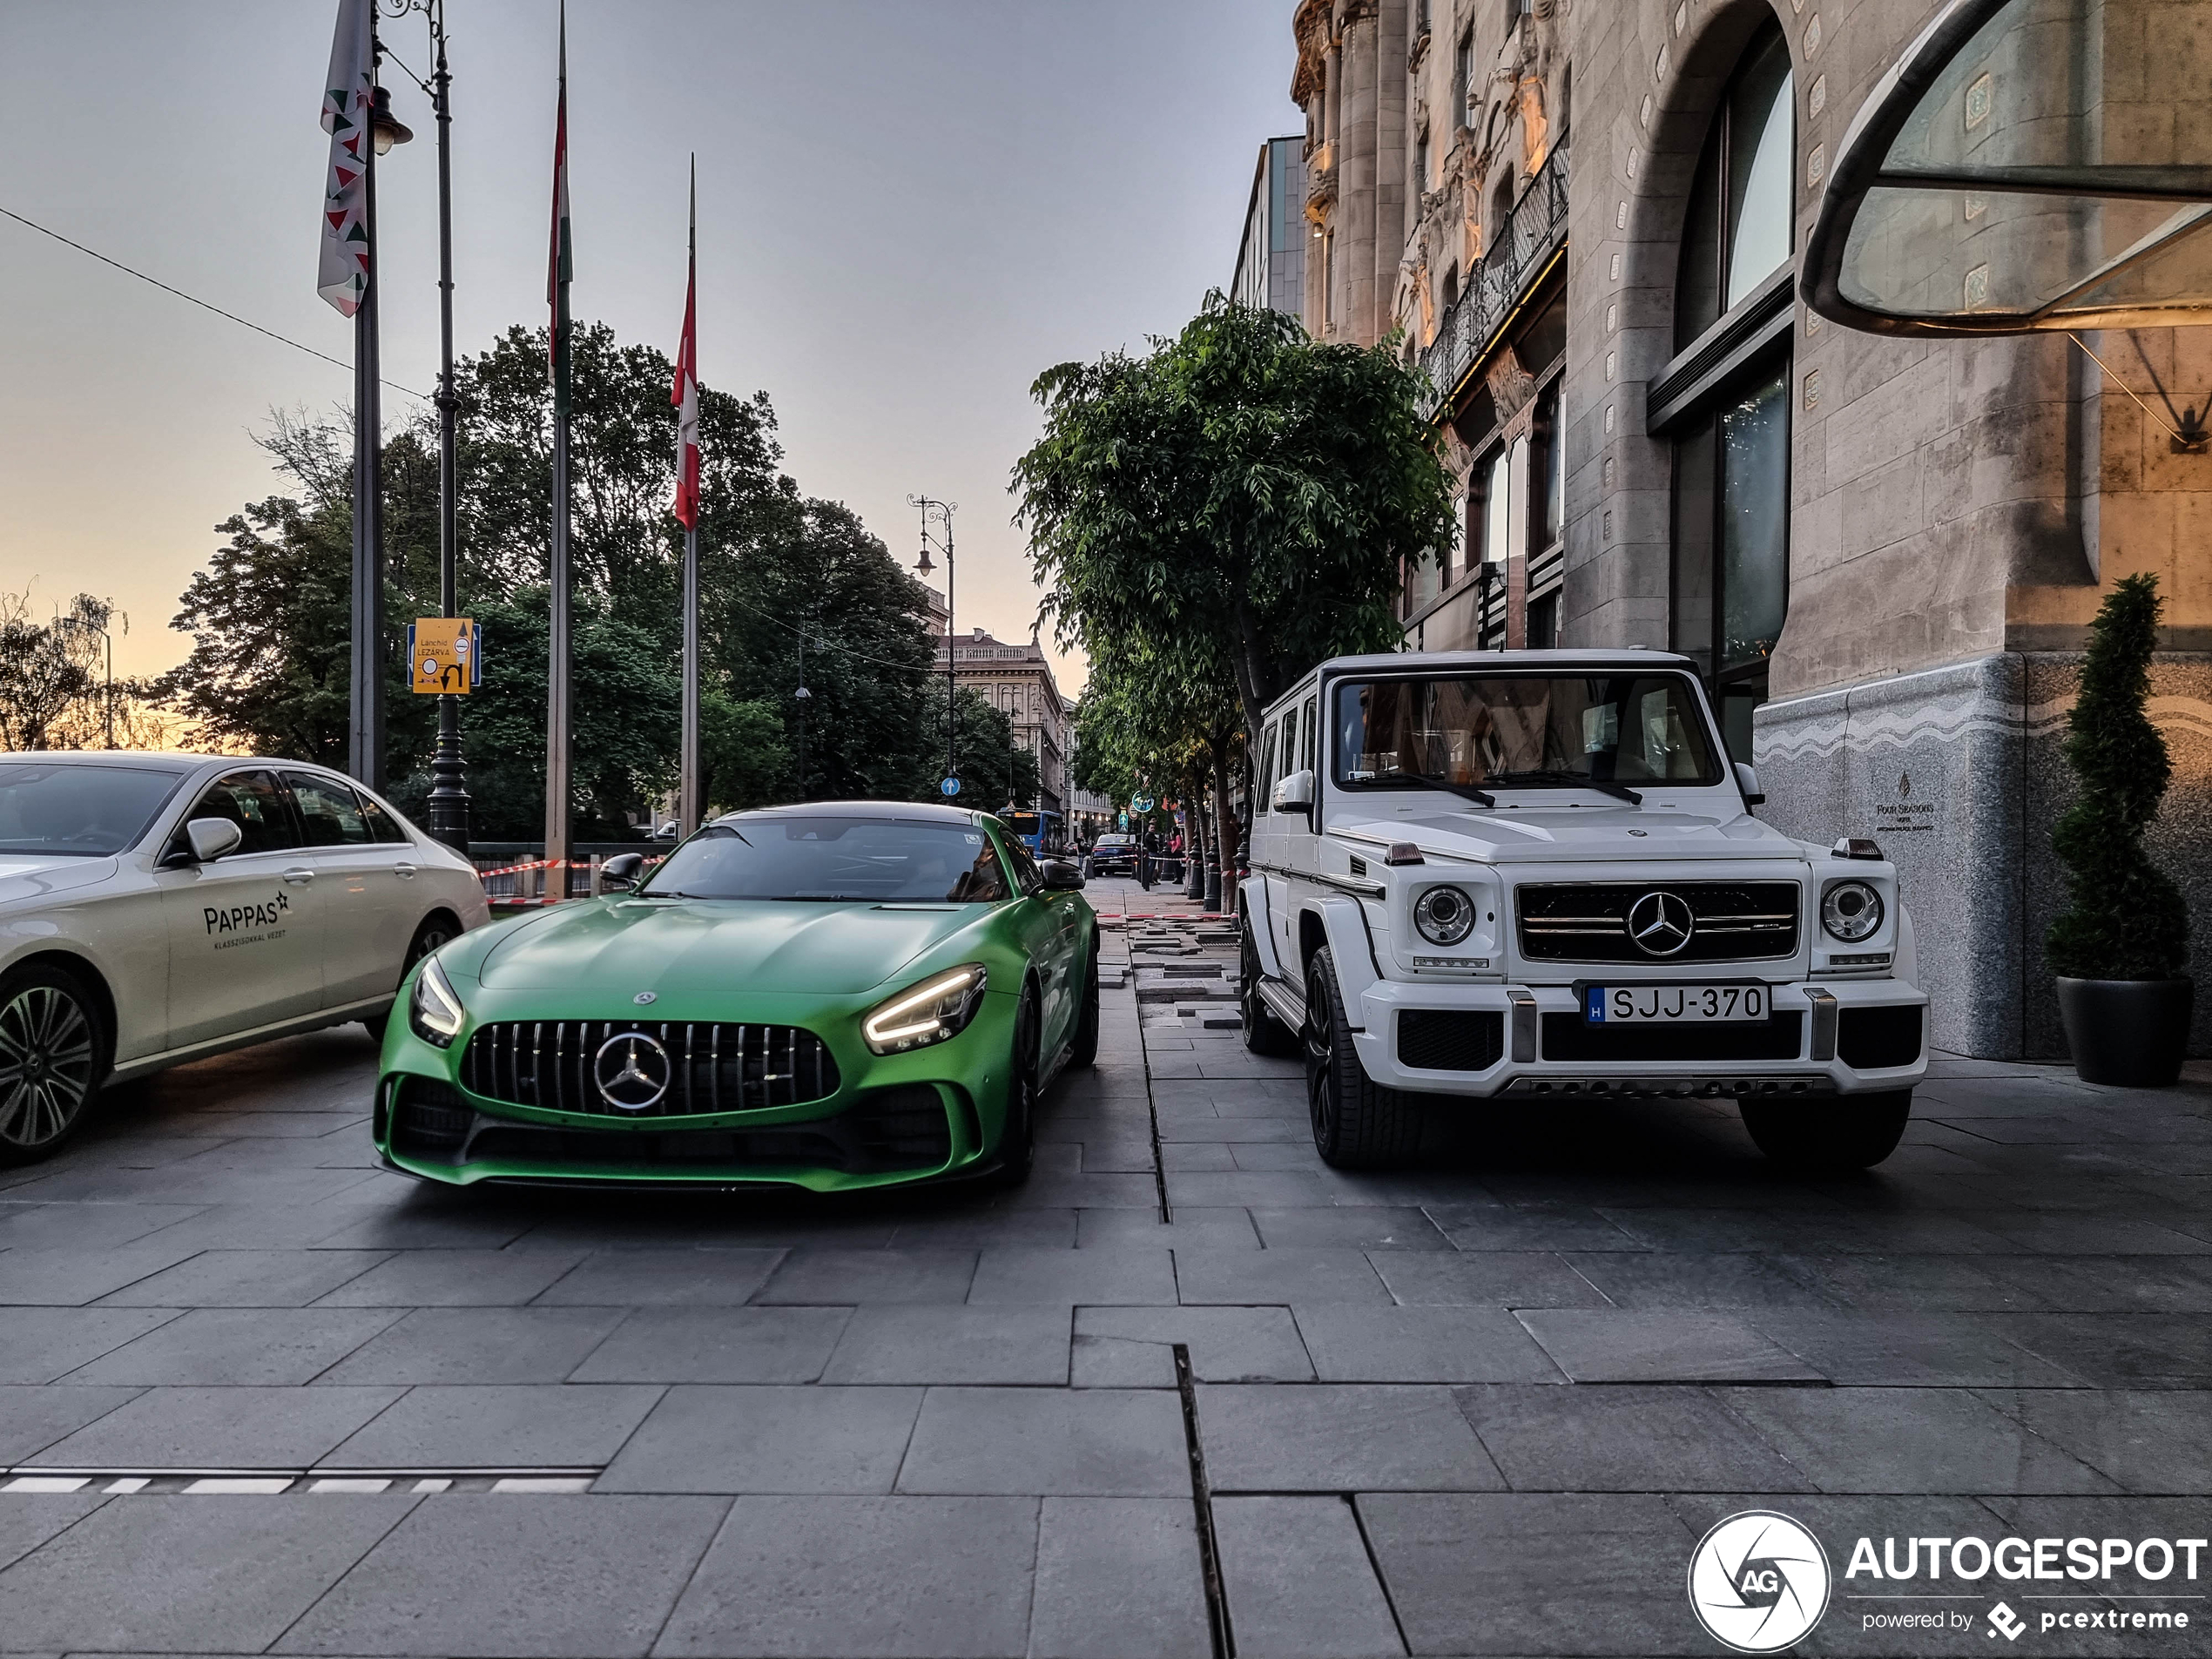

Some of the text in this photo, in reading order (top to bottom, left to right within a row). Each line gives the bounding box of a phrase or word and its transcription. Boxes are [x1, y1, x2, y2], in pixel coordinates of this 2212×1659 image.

[1877, 804, 1934, 815] FOUR SEASONS
[204, 902, 278, 935] PAPPAS
[266, 929, 287, 940] VEZET
[1591, 988, 1762, 1019] H SJJ-370
